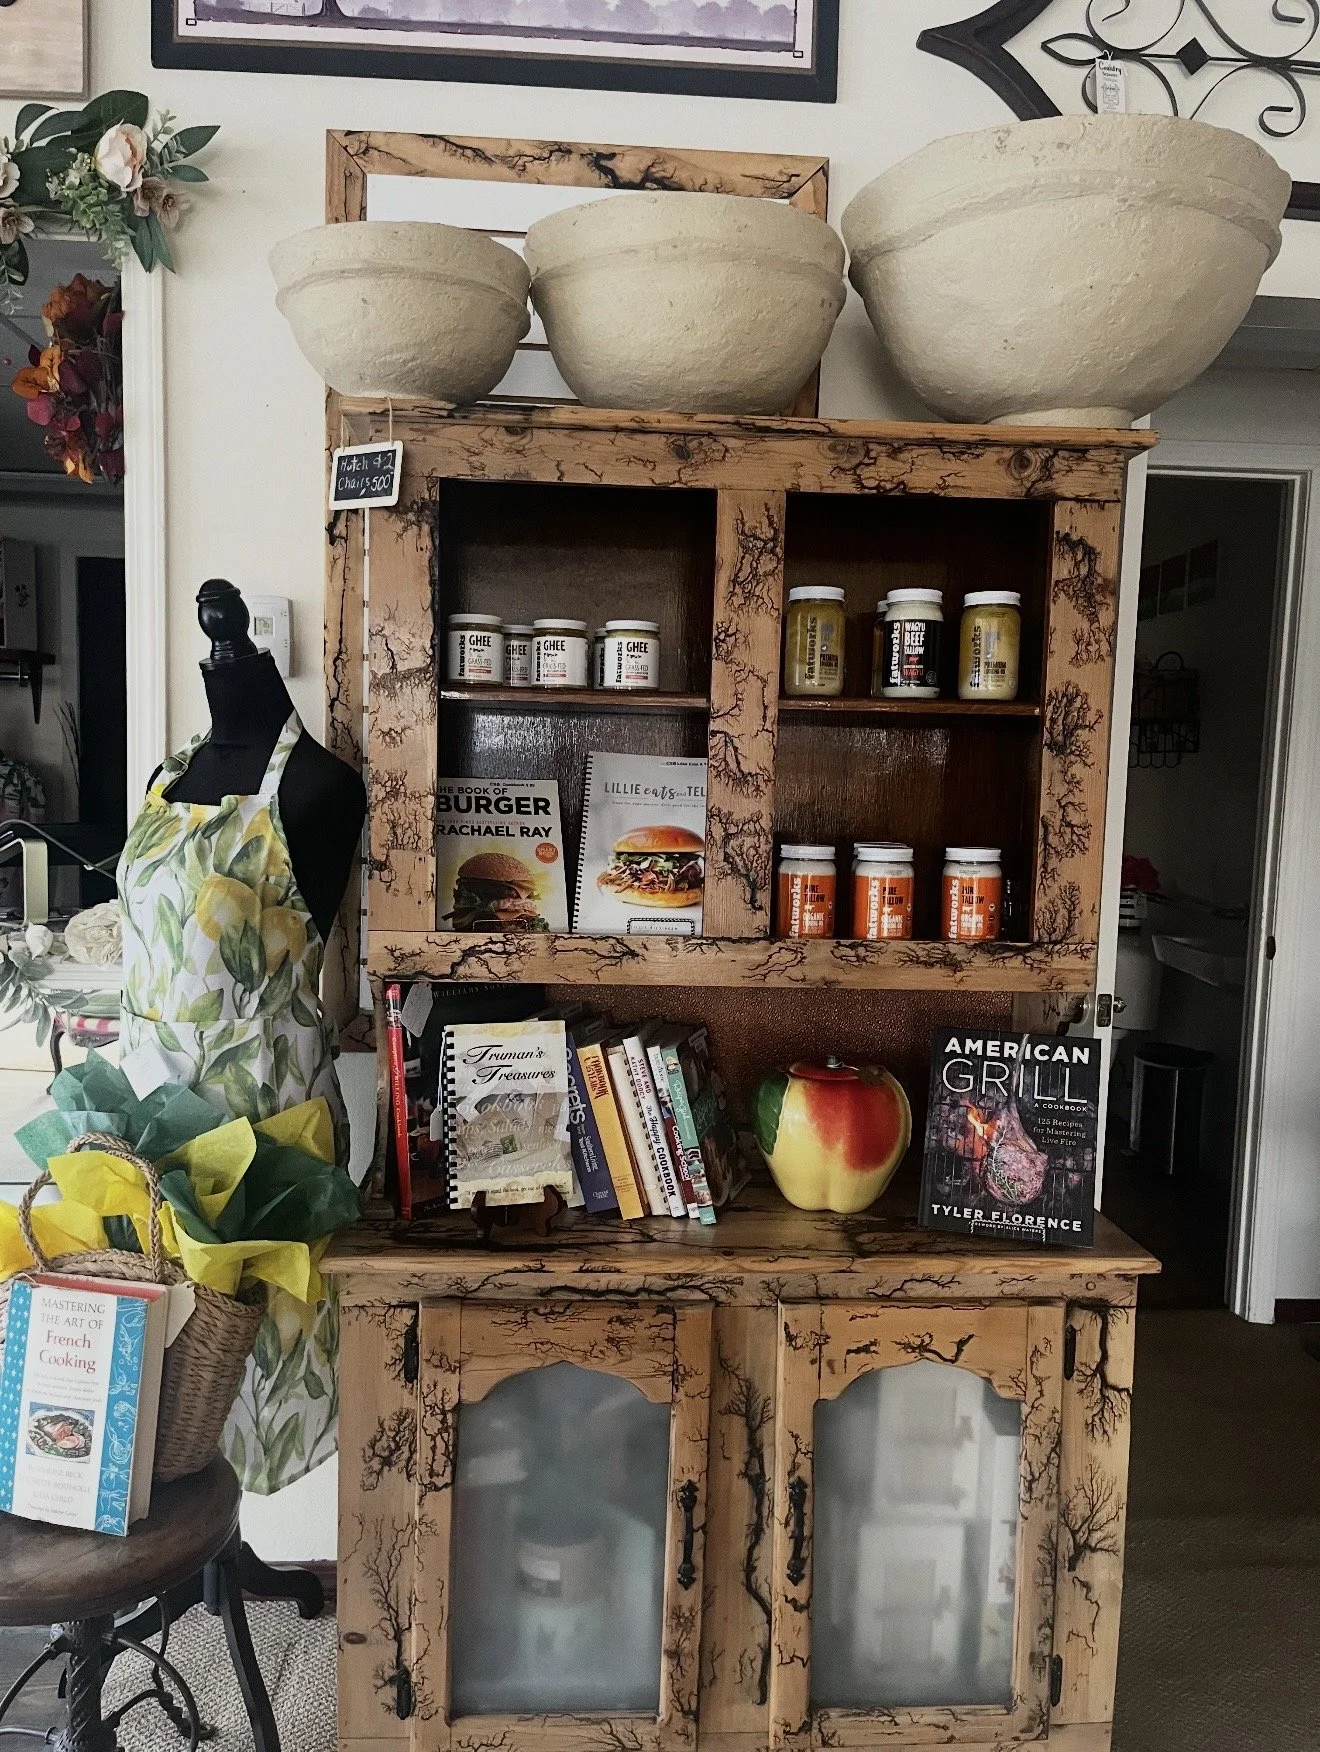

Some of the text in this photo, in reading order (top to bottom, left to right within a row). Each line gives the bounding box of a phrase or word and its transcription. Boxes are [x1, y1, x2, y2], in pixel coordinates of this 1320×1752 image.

[341, 456, 368, 472] Hutch
[905, 622, 926, 631] WAGYU
[469, 635, 492, 647] GHEE
[543, 640, 566, 651] GHEE
[626, 641, 649, 653] GHEE
[904, 631, 925, 646] BEEF
[506, 645, 528, 656] GHEE
[890, 622, 900, 685] fatworks
[457, 787, 489, 795] BOOK
[493, 788, 508, 796] OF
[605, 782, 641, 795] LILLIE
[644, 785, 677, 799] eats
[687, 786, 706, 797] TEL
[437, 795, 551, 815] BURGER
[437, 825, 552, 838] RACHAEL RAY
[463, 1044, 545, 1064] Truman's
[944, 1037, 1090, 1065] AMERICAN
[472, 1064, 556, 1084] Treasures
[638, 1059, 652, 1094] STEVE AND
[942, 1058, 1088, 1104] GRILL
[1042, 1103, 1087, 1112] COOKBOOK
[1037, 1117, 1083, 1128] 125 Recipes
[1041, 1136, 1077, 1146] Live Fire
[1046, 1127, 1086, 1139] Mastering
[649, 1116, 663, 1146] Happy
[656, 1146, 677, 1198] COOKBOOK
[672, 1125, 685, 1157] Cooking
[680, 1155, 692, 1181] School
[931, 1204, 1082, 1232] TYLER FLORENCE
[41, 1297, 106, 1314] MASTERING
[41, 1313, 104, 1330] THE ART OF
[47, 1330, 91, 1349] French
[39, 1349, 97, 1374] Cooking
